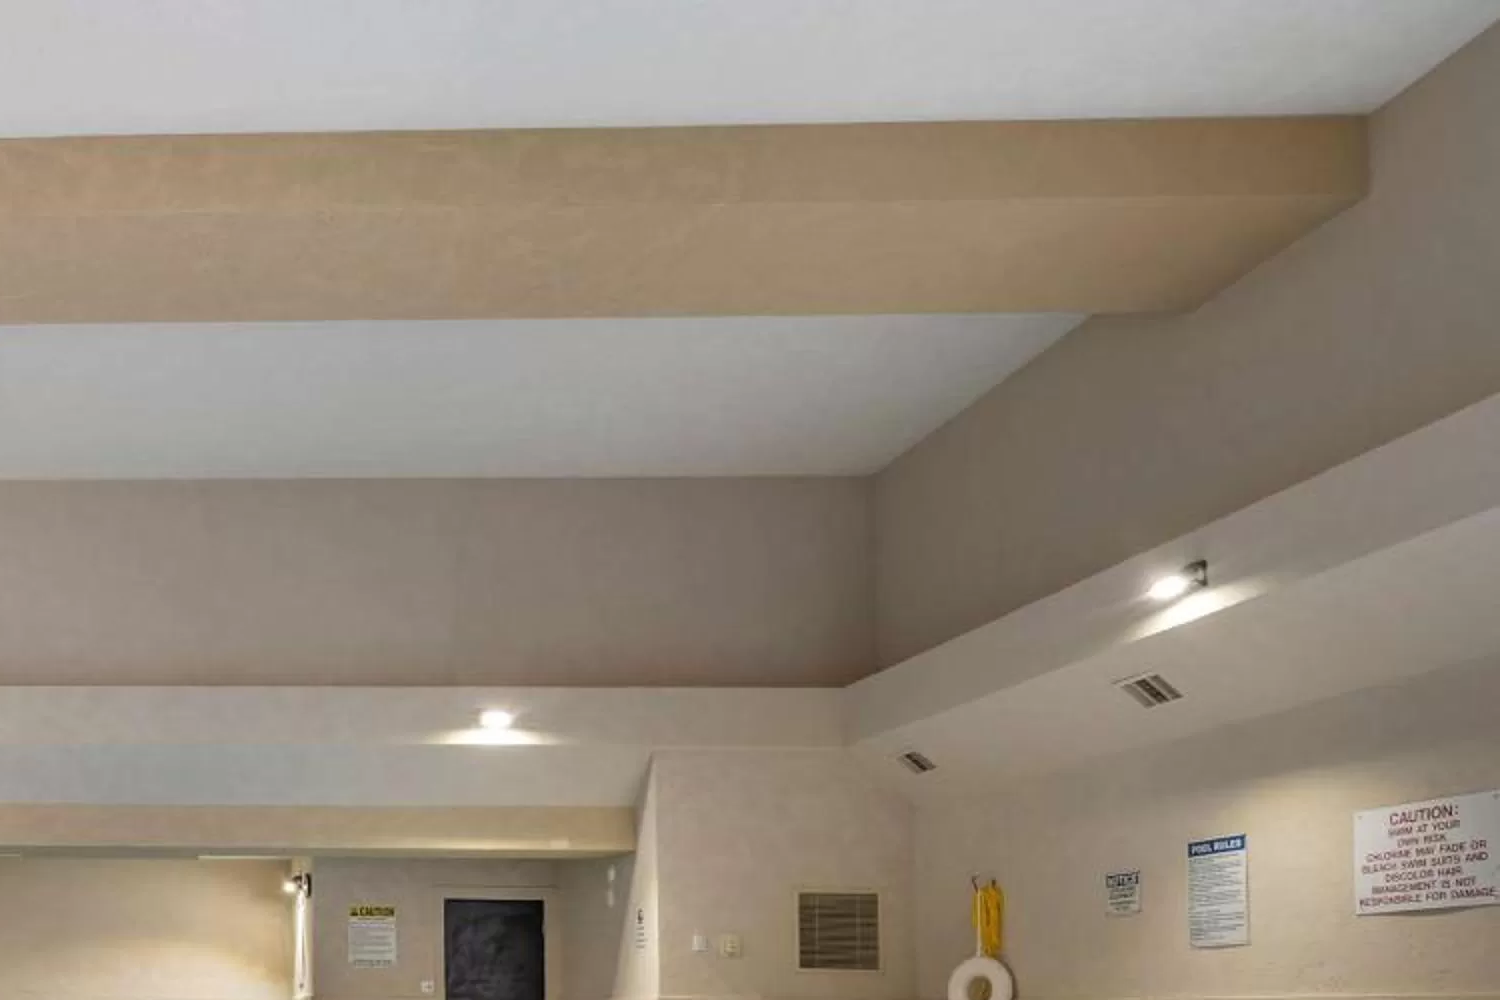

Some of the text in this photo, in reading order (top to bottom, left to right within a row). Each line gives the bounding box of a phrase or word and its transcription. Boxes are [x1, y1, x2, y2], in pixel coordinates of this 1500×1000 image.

[1389, 804, 1459, 826] CAUTION:
[1432, 819, 1460, 832] YOUR
[1191, 838, 1242, 855] POOL RULES
[1439, 841, 1467, 854] FADE
[1470, 839, 1487, 850] OR
[1362, 862, 1397, 875] BLEACH
[1431, 854, 1461, 867] SUITS
[1465, 851, 1489, 862] AND
[1385, 869, 1434, 883] DISCOLOR
[1455, 876, 1477, 887] NOT
[1425, 890, 1448, 901] FOR
